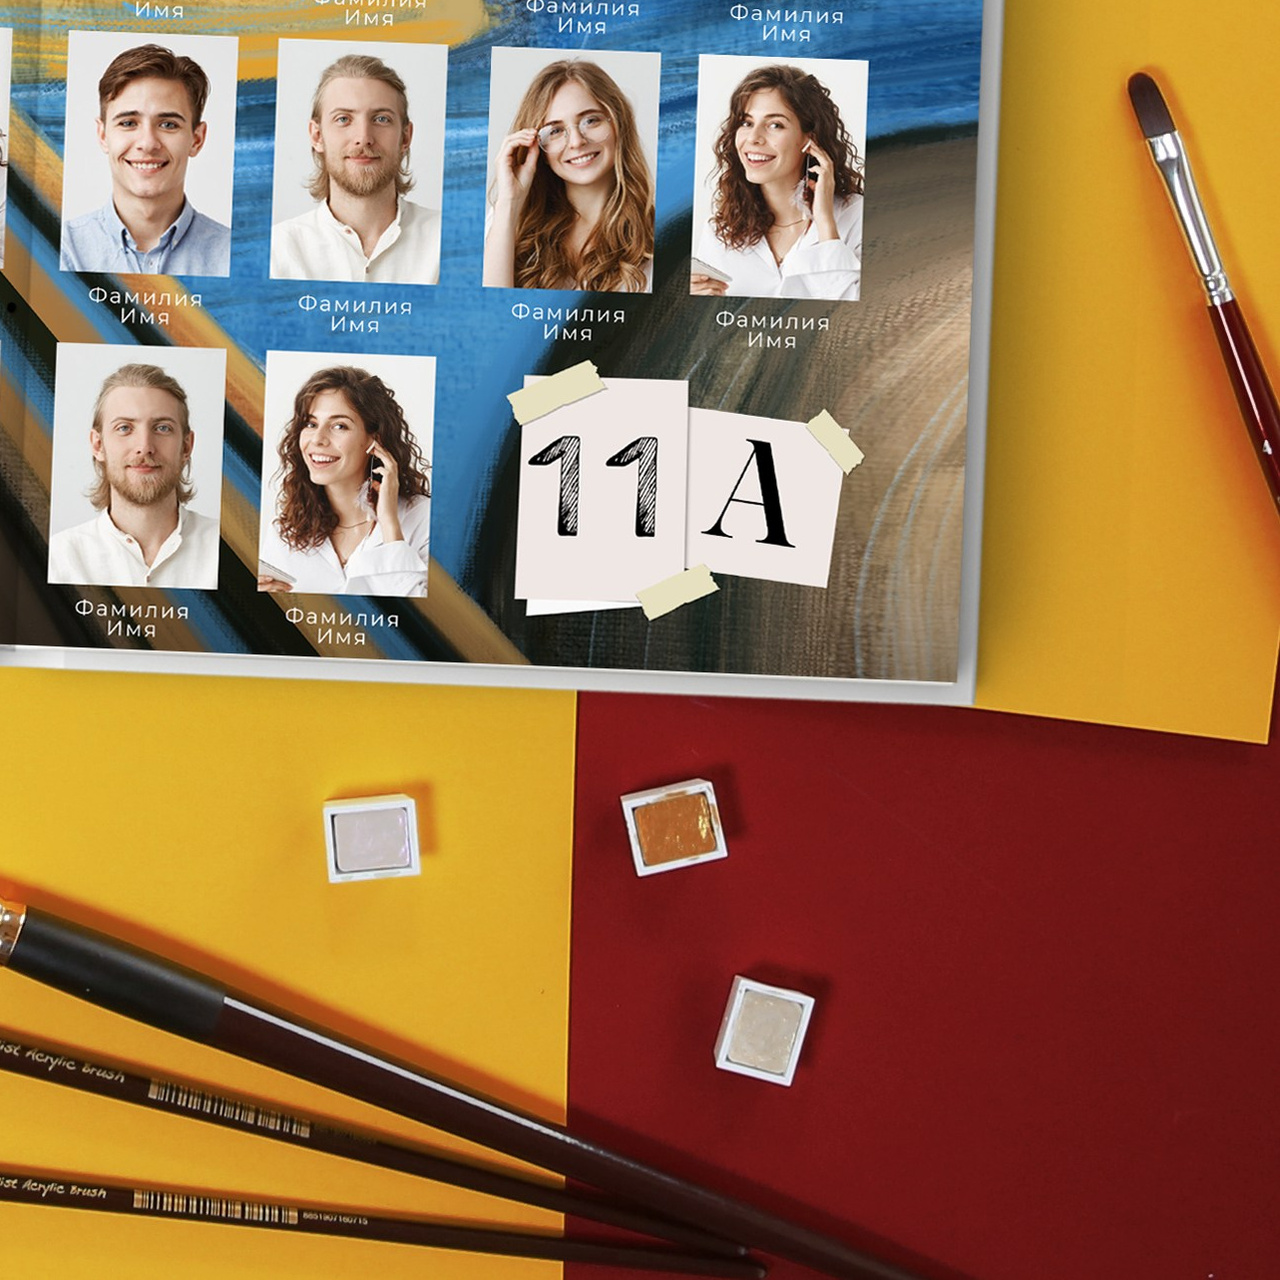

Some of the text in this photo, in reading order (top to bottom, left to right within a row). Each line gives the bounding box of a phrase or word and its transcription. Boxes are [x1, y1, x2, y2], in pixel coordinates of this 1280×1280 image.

[134, 1, 185, 20] Имя
[344, 8, 395, 27] Имя
[729, 3, 844, 25] Фамилия
[557, 16, 608, 35] Имя
[761, 24, 812, 43] Имя
[88, 286, 203, 308] Фамилия
[298, 294, 413, 316] Фамилия
[120, 307, 171, 326] Имя
[511, 302, 626, 324] Фамилия
[715, 310, 830, 332] Фамилия
[330, 315, 381, 334] Имя
[543, 323, 594, 342] Имя
[747, 331, 798, 350] Имя
[528, 435, 797, 549] 11 А
[74, 599, 189, 621] Фамилия
[284, 606, 399, 628] Фамилия
[106, 620, 157, 639] Имя
[316, 627, 367, 646] Имя
[25, 1048, 77, 1072] Acrylic
[82, 1062, 126, 1084] Brush
[22, 1178, 66, 1198] Acrylic
[70, 1184, 108, 1199] Brush
